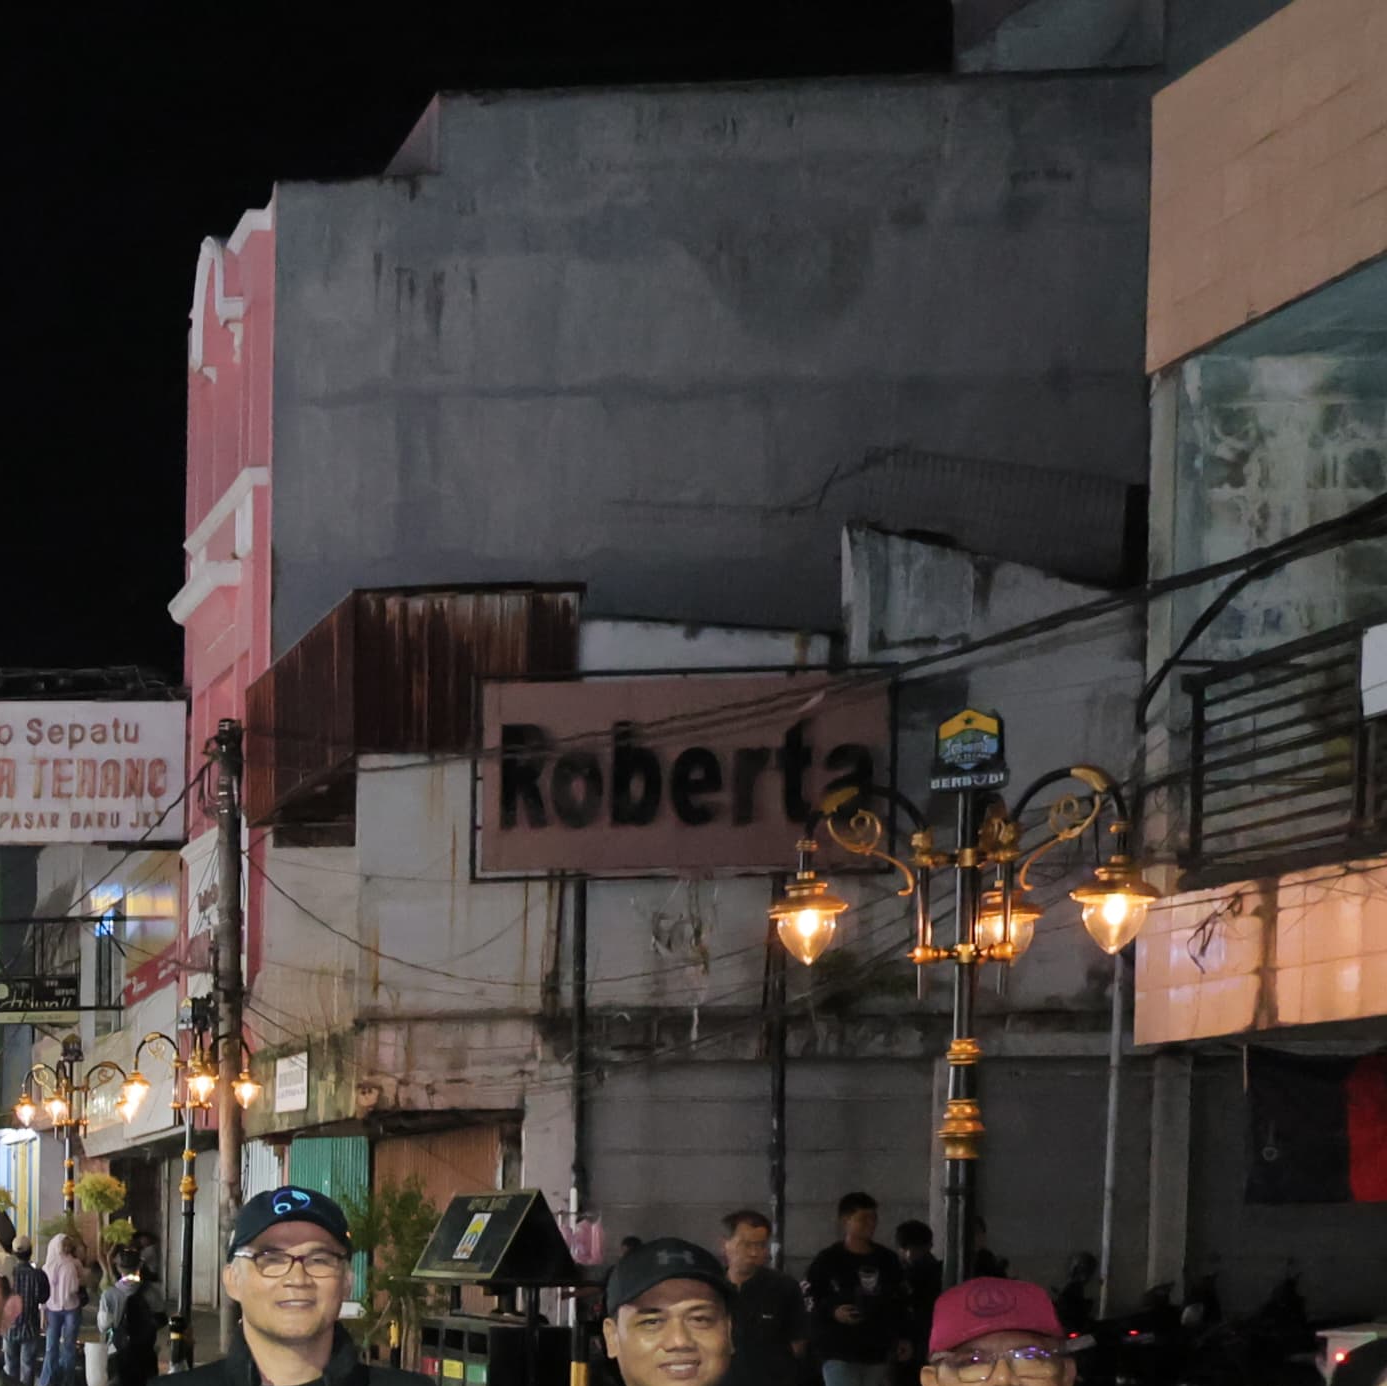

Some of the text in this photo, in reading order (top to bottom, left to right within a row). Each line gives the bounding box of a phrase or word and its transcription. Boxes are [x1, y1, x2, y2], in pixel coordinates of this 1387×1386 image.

[26, 717, 139, 750] Sepatu
[28, 756, 167, 800] TERANG
[70, 810, 121, 830] BARU
